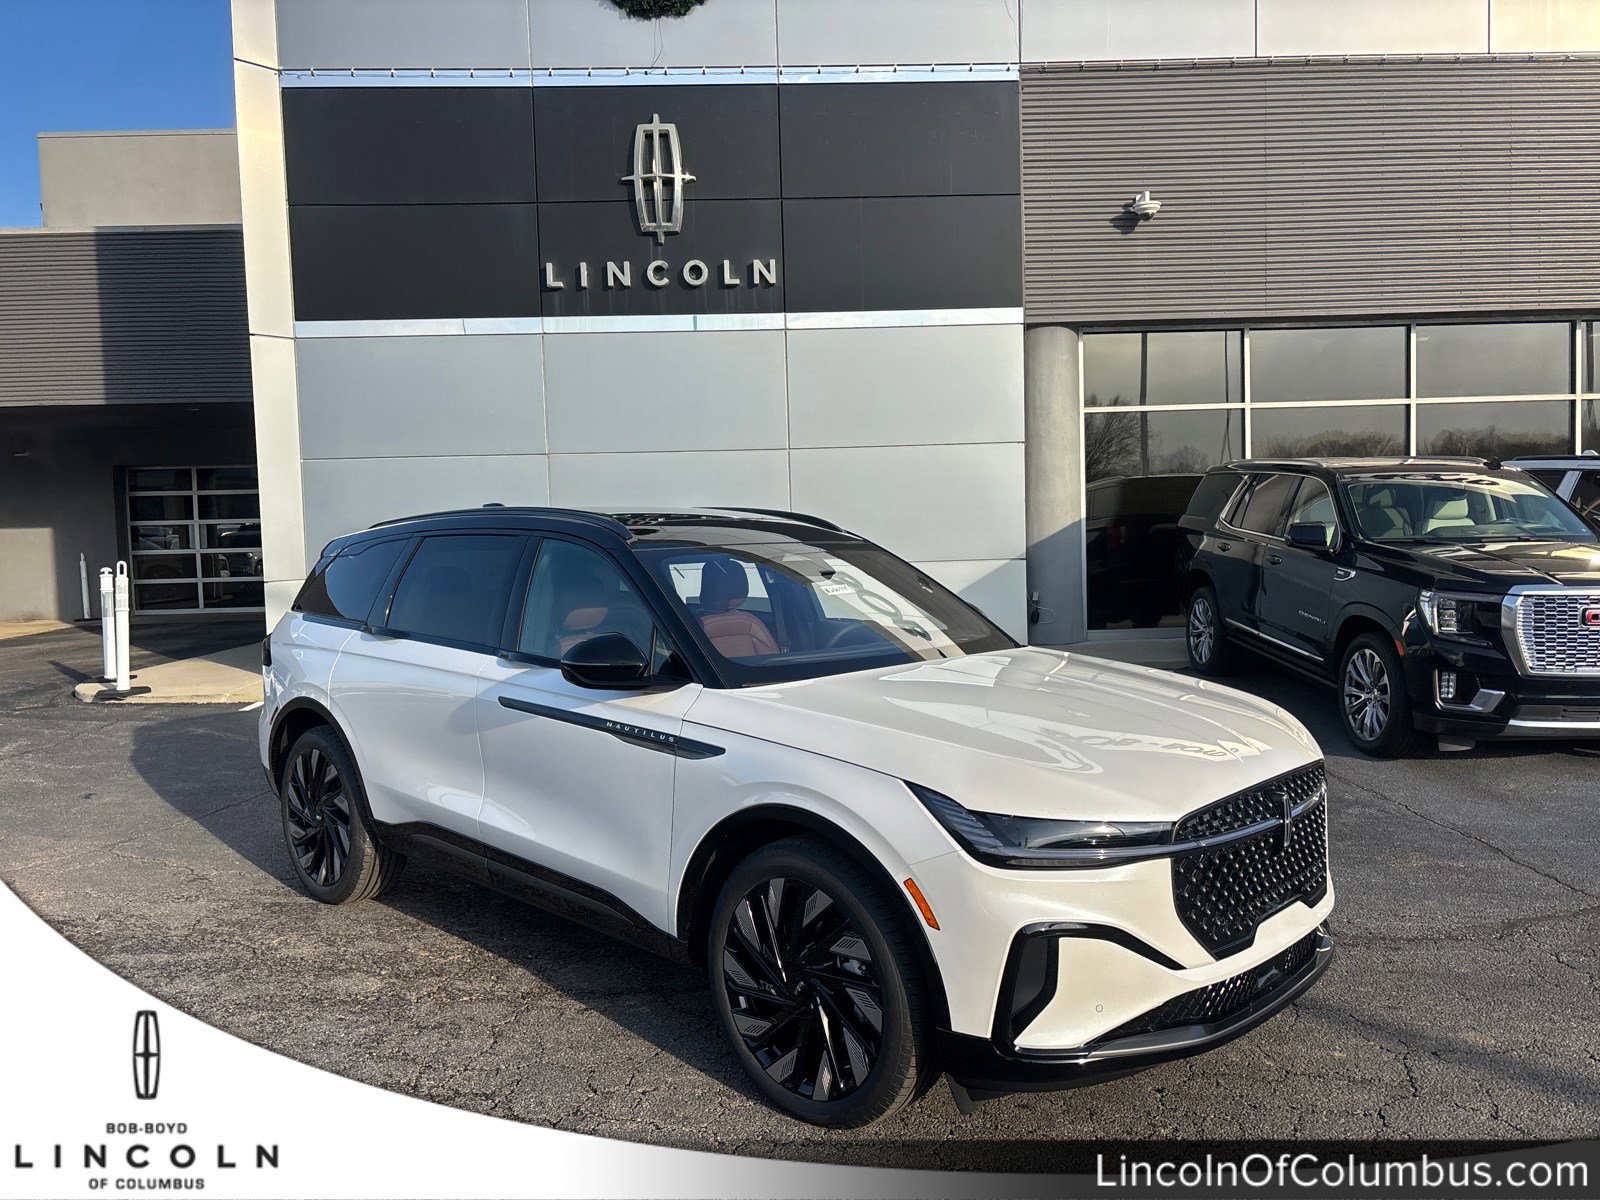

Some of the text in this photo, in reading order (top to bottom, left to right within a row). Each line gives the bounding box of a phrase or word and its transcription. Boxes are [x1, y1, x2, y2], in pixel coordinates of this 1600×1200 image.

[545, 258, 777, 289] LINCOLN
[1298, 610, 1326, 625] DENALI
[606, 721, 675, 743] NAUTILUS
